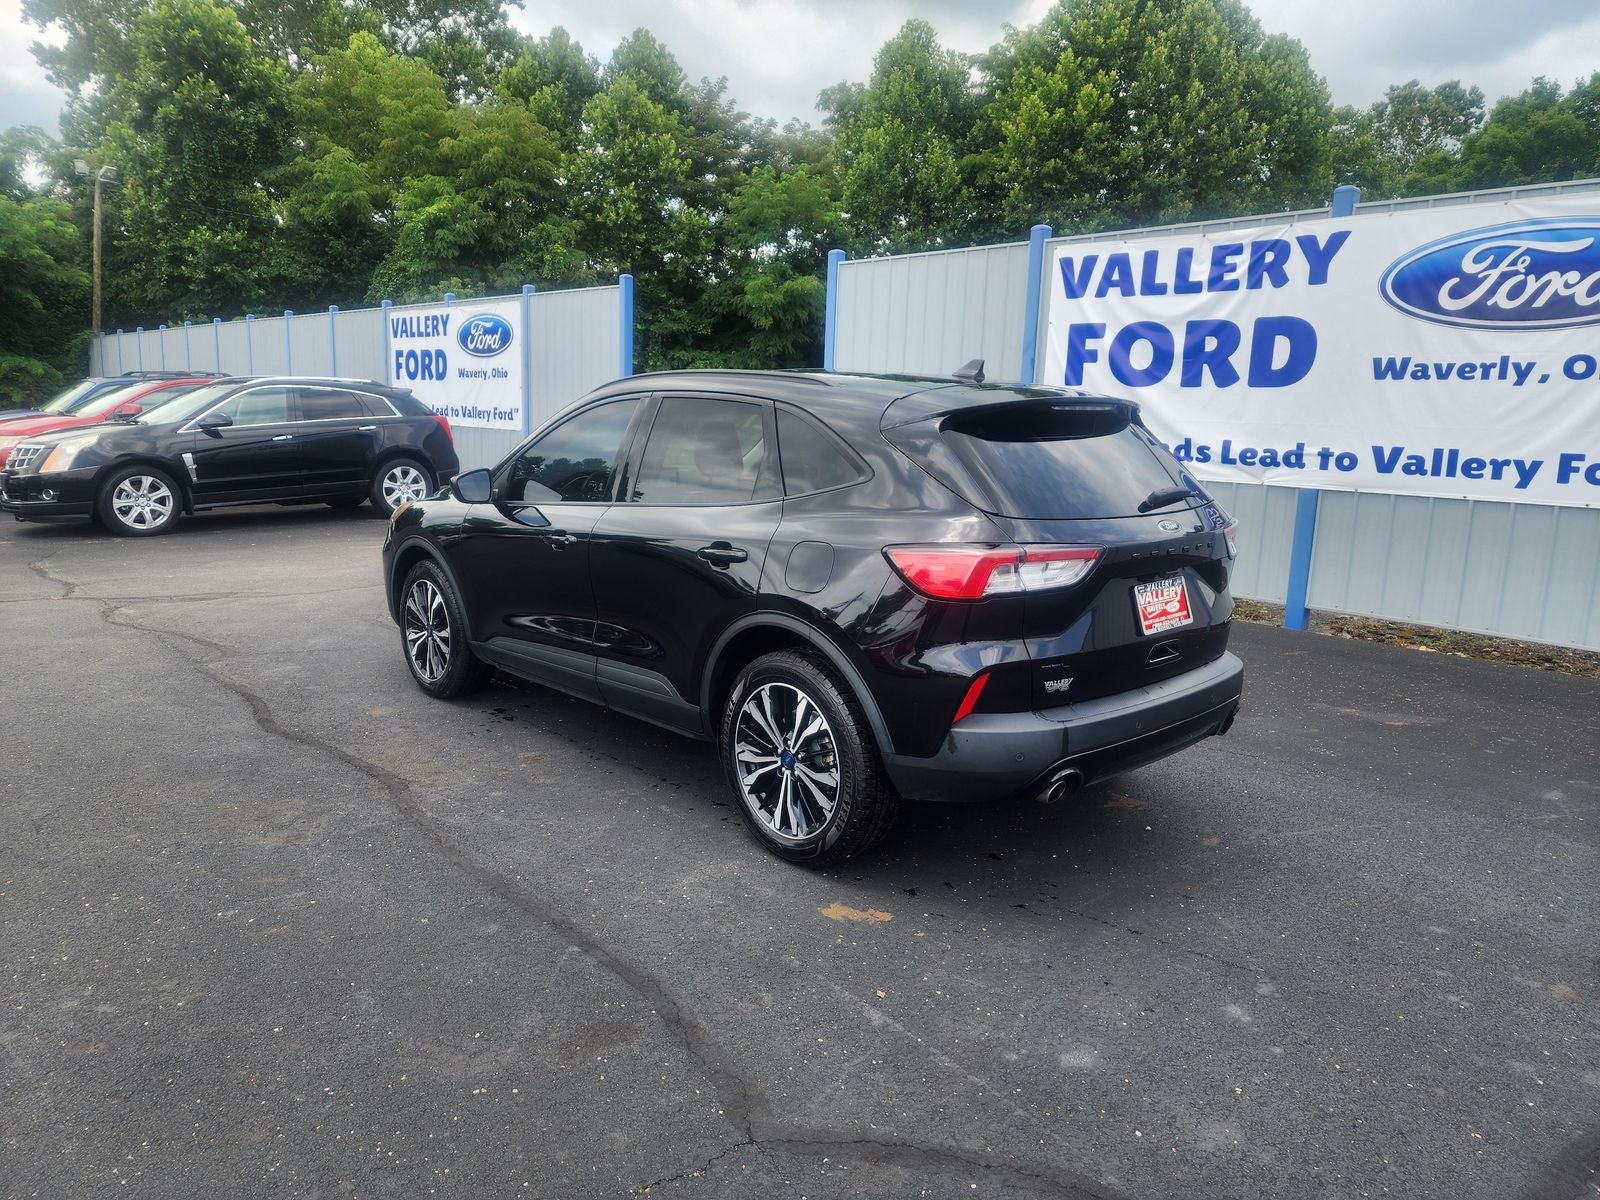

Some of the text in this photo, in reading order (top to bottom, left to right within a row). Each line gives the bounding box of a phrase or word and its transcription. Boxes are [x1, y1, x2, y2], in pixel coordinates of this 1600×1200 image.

[1059, 230, 1352, 300] VALLERY
[391, 313, 450, 339] VALLERY
[467, 320, 502, 350] Ford
[395, 349, 448, 381] FORD
[1064, 315, 1318, 388] FORD
[457, 367, 508, 381] Waverly, Ohio
[1372, 353, 1600, 387] Waverly, O
[450, 406, 460, 418] to
[461, 404, 492, 423] Vallery
[493, 407, 519, 421] Ford"
[1220, 439, 1307, 470] Lead
[1317, 447, 1359, 473] to
[1371, 445, 1544, 489] Vallery
[1138, 585, 1182, 605] VALLERY
